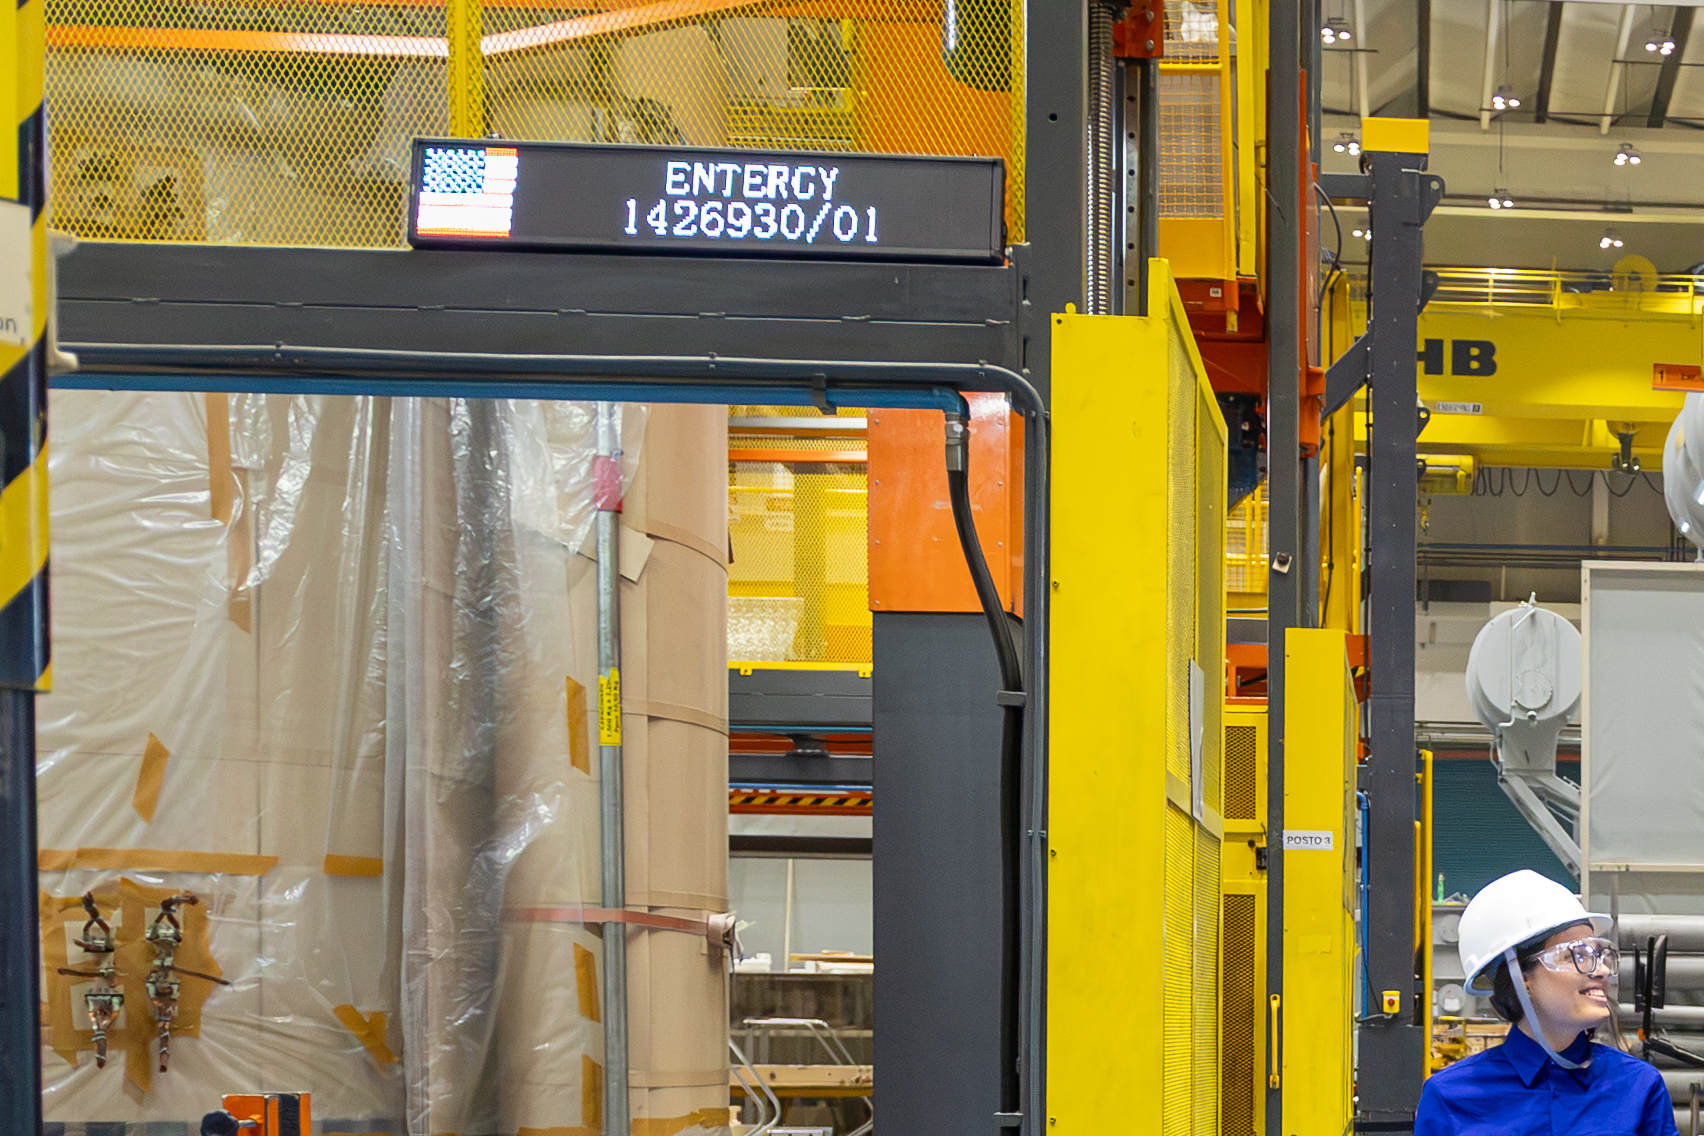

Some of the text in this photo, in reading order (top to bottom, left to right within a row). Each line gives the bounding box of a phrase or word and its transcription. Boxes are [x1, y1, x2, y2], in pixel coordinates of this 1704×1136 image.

[665, 161, 839, 200] ENTERGY
[624, 198, 878, 244] 1426930/01
[1286, 835, 1323, 846] POSTO
